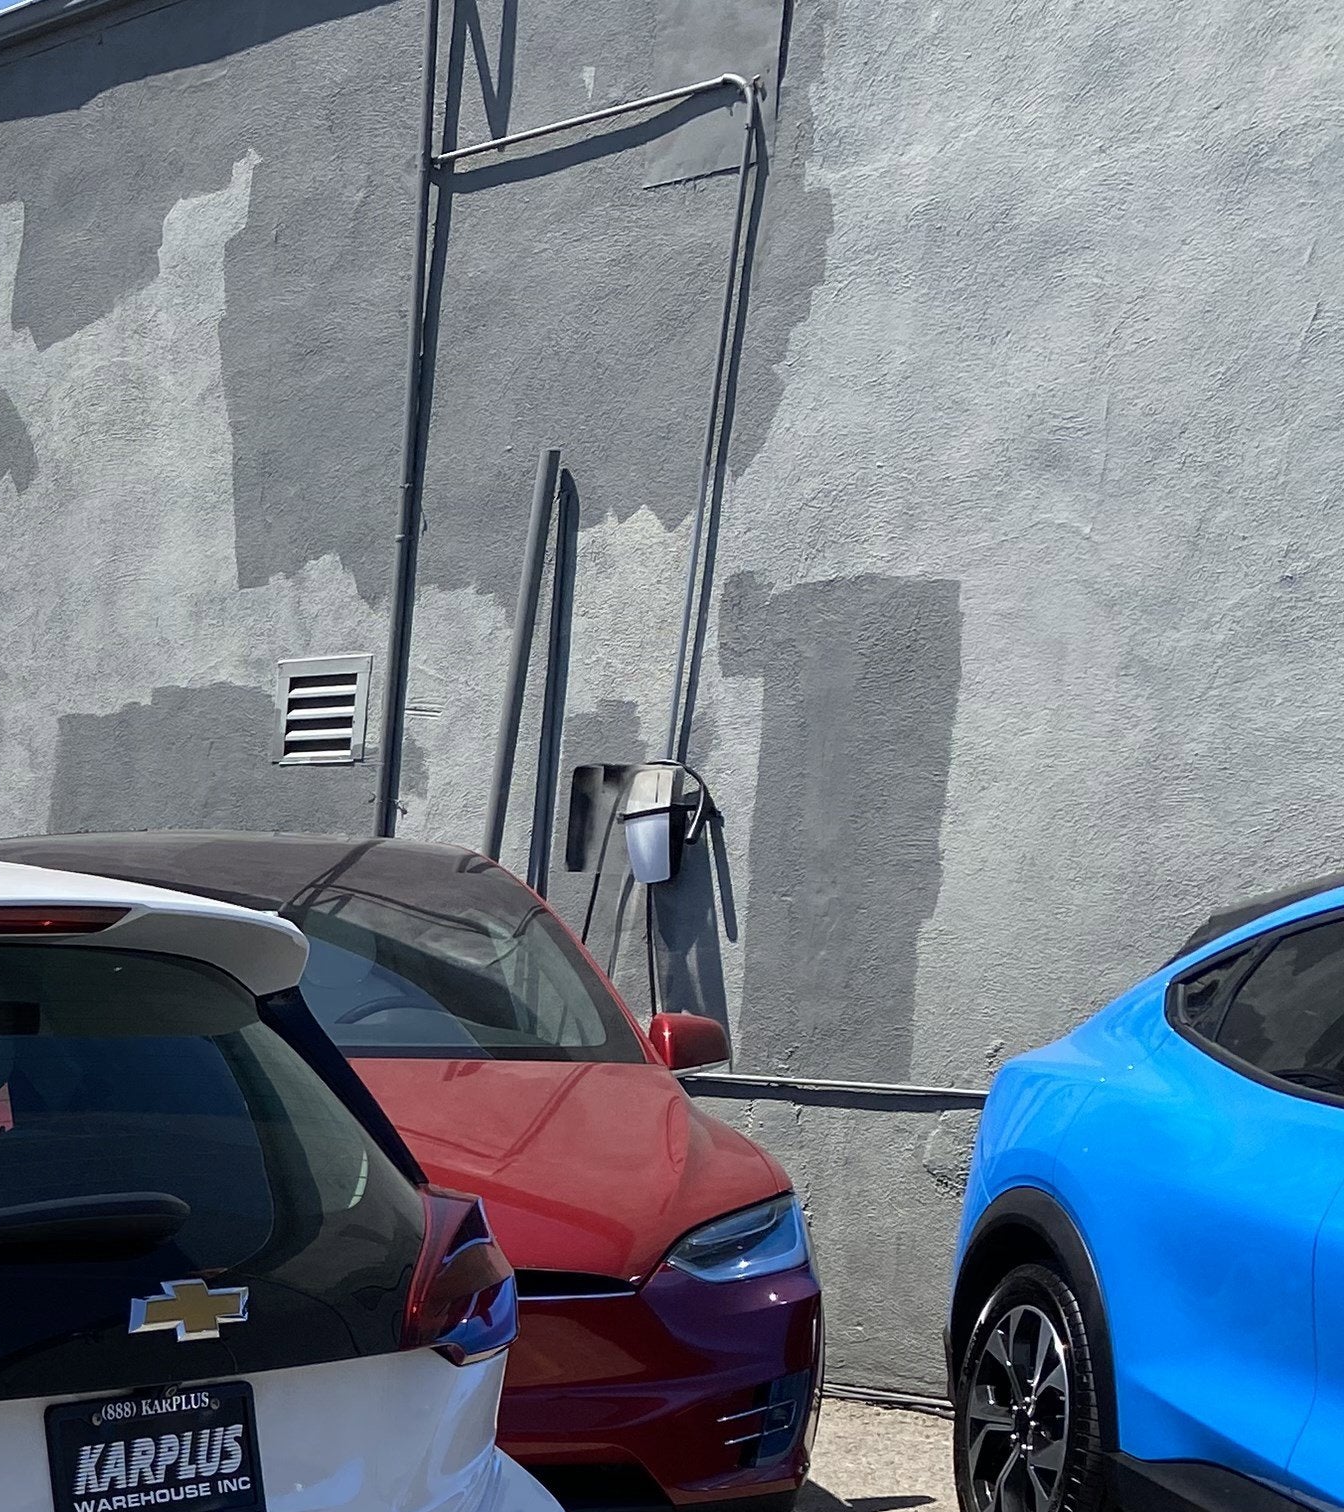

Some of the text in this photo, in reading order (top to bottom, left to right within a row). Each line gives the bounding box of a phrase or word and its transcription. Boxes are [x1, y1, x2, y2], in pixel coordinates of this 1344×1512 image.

[102, 1392, 209, 1421] (888) KARPLUS
[72, 1424, 243, 1495] KARPLUS
[218, 1476, 251, 1494] INC
